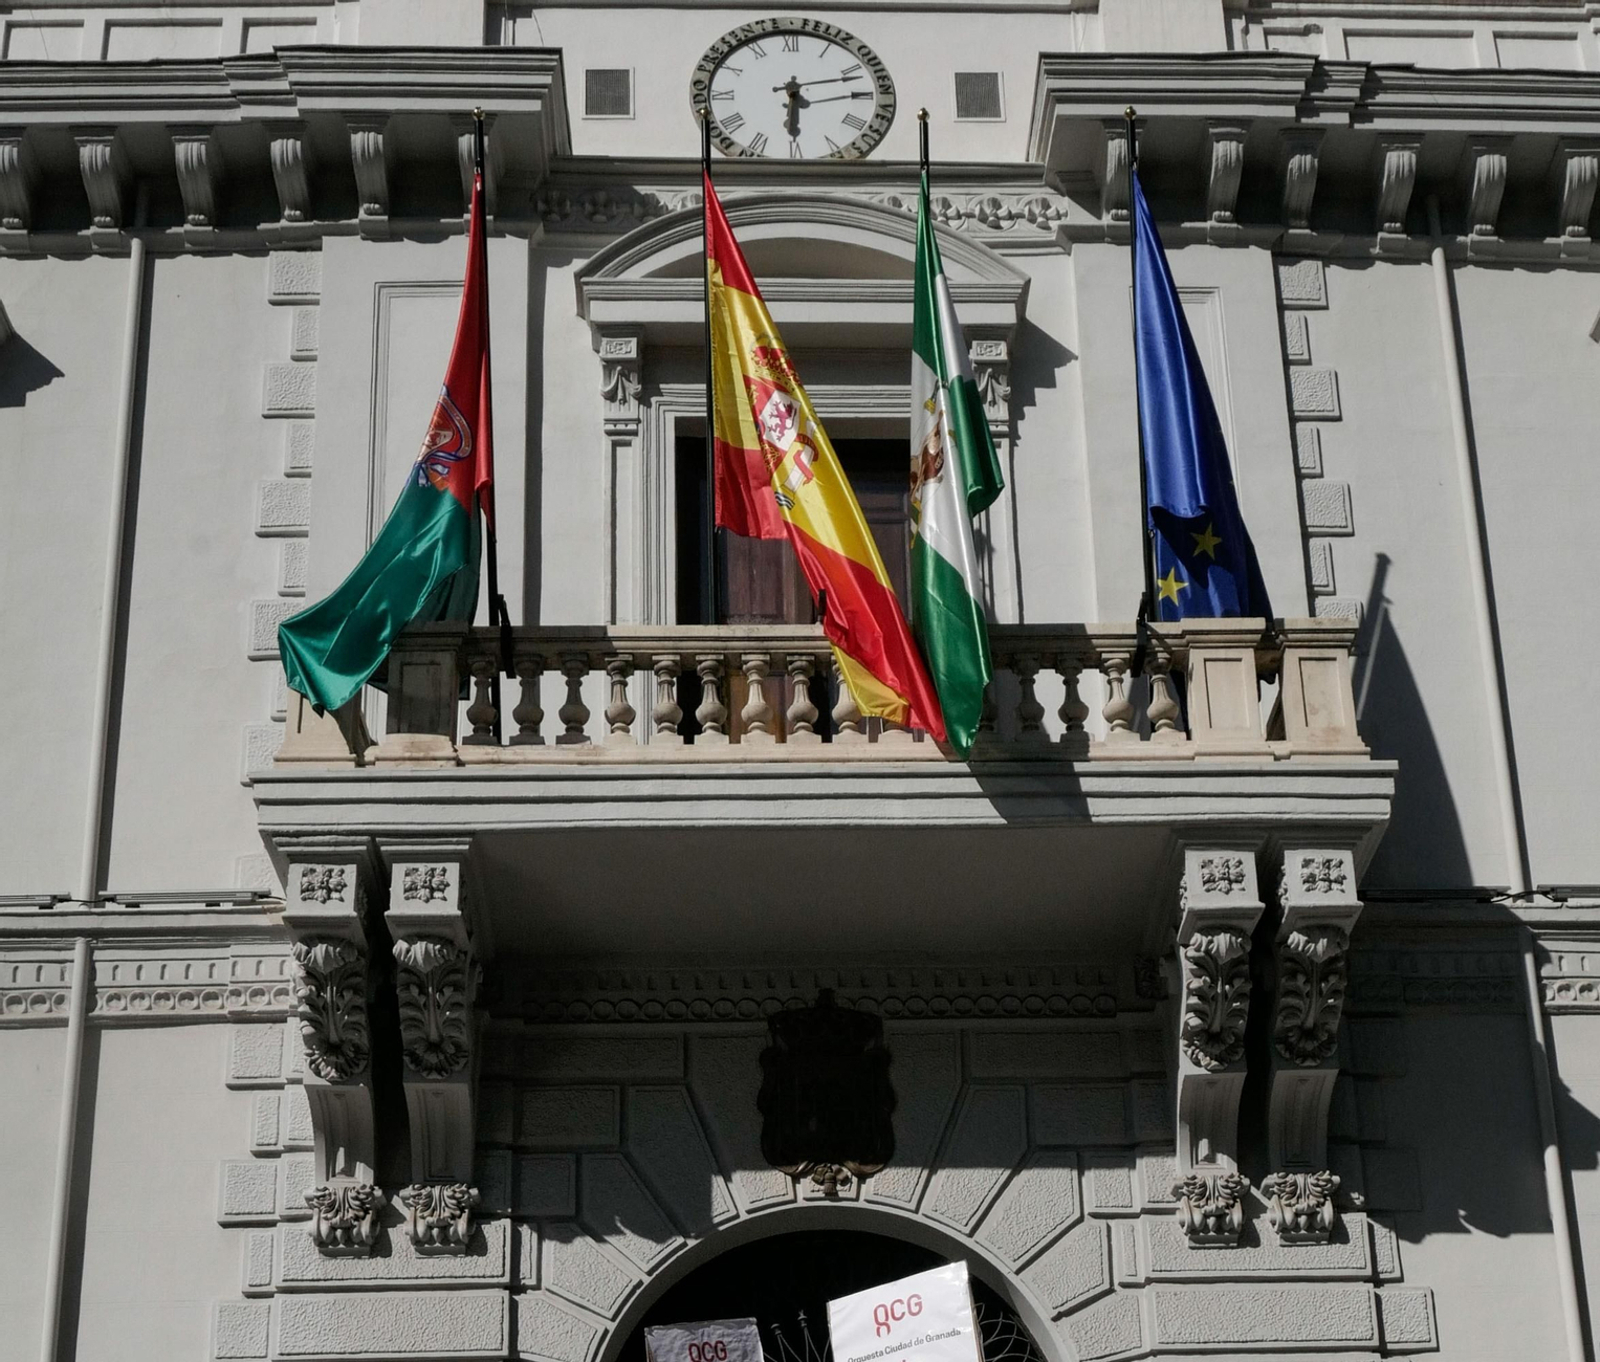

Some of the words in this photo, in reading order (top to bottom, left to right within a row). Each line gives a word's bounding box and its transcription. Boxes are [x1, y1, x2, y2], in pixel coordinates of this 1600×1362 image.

[800, 18, 854, 45] FELIZ
[697, 18, 780, 73] PRESENTE
[746, 41, 767, 60] XI
[782, 35, 799, 52] XII
[719, 63, 743, 76] X
[841, 63, 862, 75] II
[857, 45, 894, 95] QUIEN
[712, 90, 734, 100] IX
[841, 113, 868, 131] IIII
[875, 103, 894, 122] VE
[720, 112, 746, 135] VIII
[748, 132, 768, 153] VII
[789, 141, 803, 158] VI
[873, 1294, 923, 1338] OCG
[884, 1340, 913, 1356] Ciudad
[914, 1337, 924, 1346] de
[925, 1328, 961, 1343] Granada
